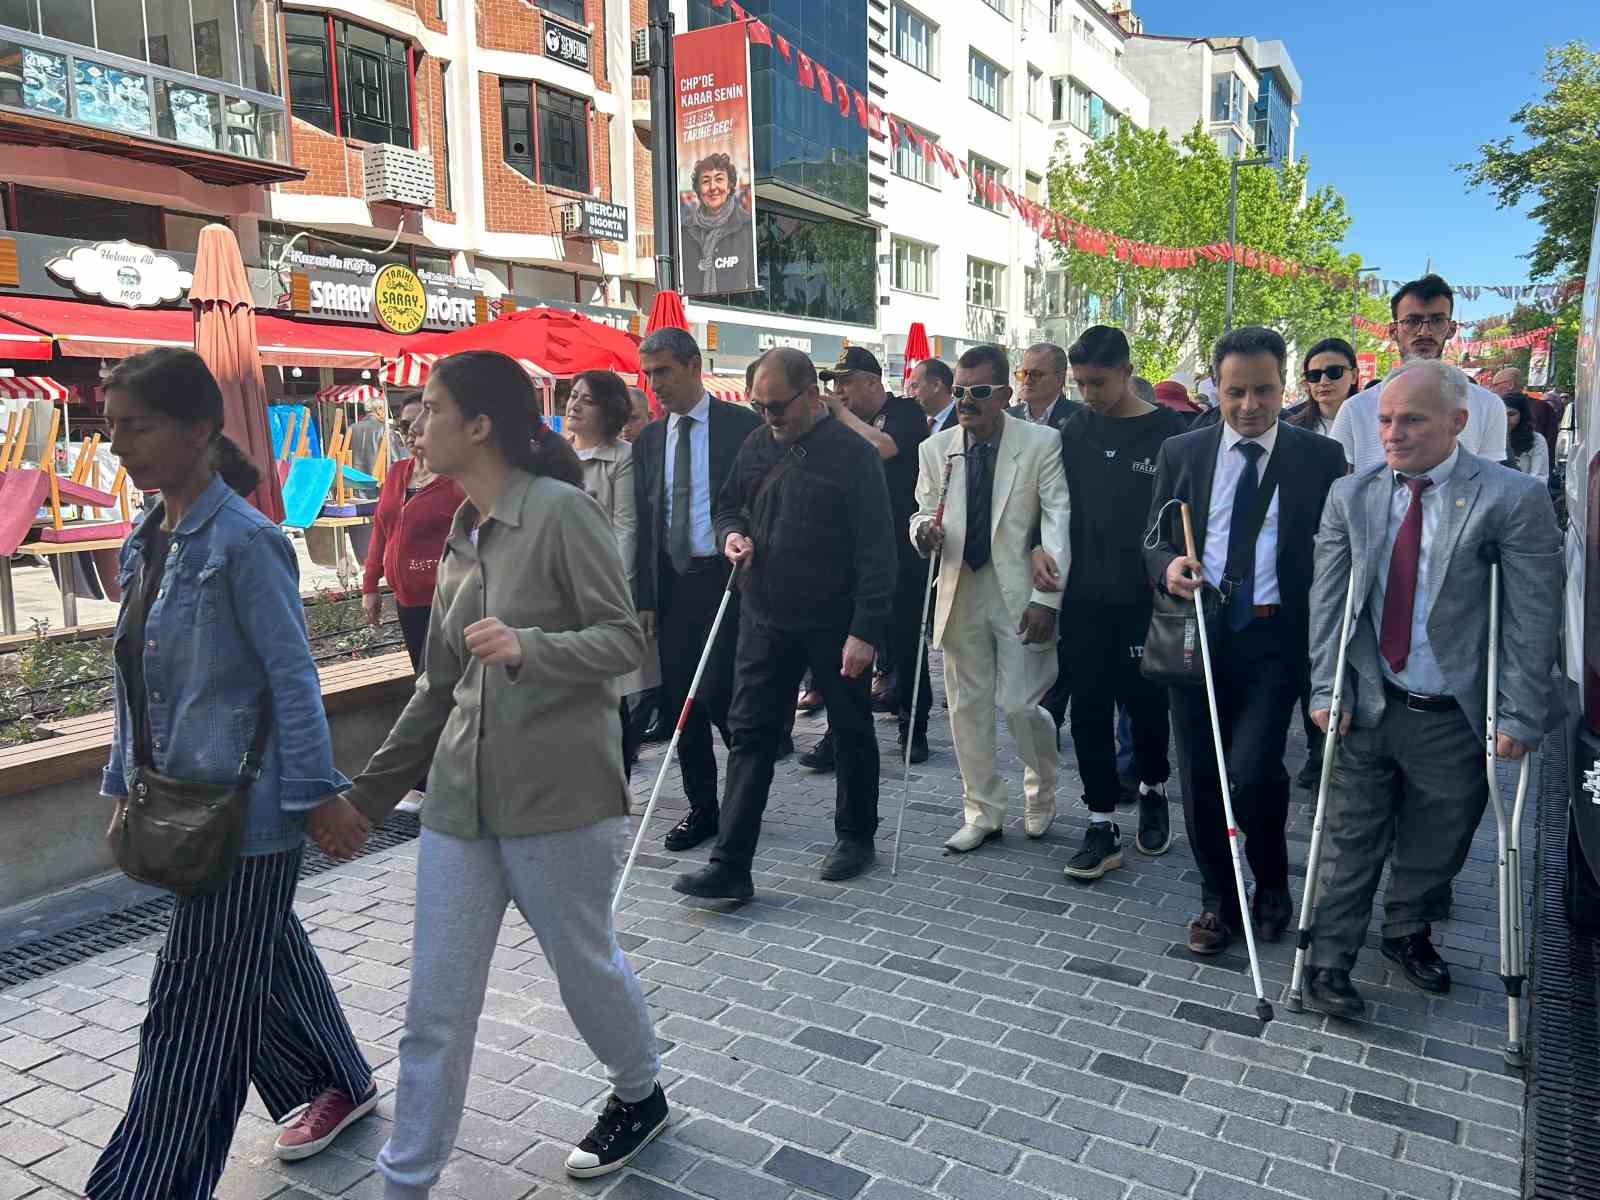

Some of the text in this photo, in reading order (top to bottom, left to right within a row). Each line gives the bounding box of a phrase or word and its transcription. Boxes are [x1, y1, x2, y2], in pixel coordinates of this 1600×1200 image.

[681, 74, 715, 92] CHP'DE
[681, 83, 744, 108] KARAR SENİN
[585, 200, 626, 220] MERCAN
[589, 215, 623, 231] SİGORTA
[715, 256, 739, 269] CHP
[310, 280, 373, 313] SARAY
[382, 291, 419, 307] SARAY
